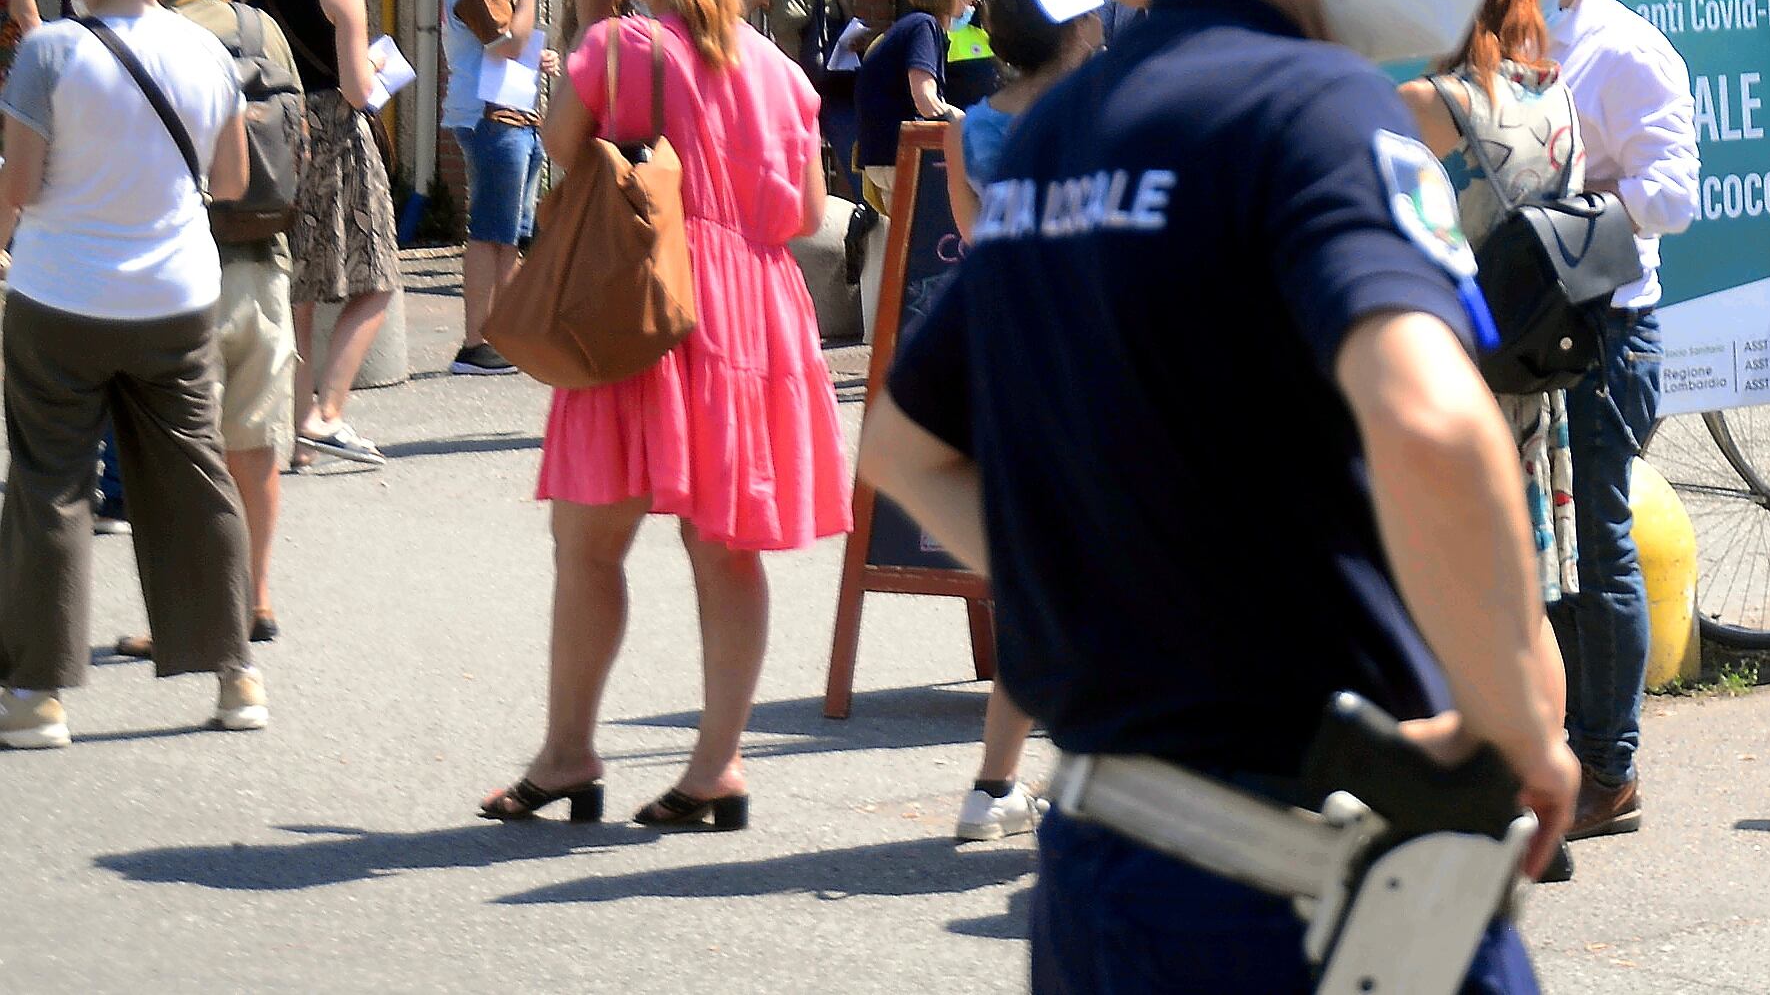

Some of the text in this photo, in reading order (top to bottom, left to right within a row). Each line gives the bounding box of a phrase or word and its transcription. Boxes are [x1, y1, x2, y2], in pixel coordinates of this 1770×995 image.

[1744, 340, 1769, 352] ASST
[1744, 358, 1769, 370] ASST
[1663, 365, 1713, 381] Regione
[1663, 377, 1727, 394] Lombardia
[1744, 379, 1769, 392] ASST
